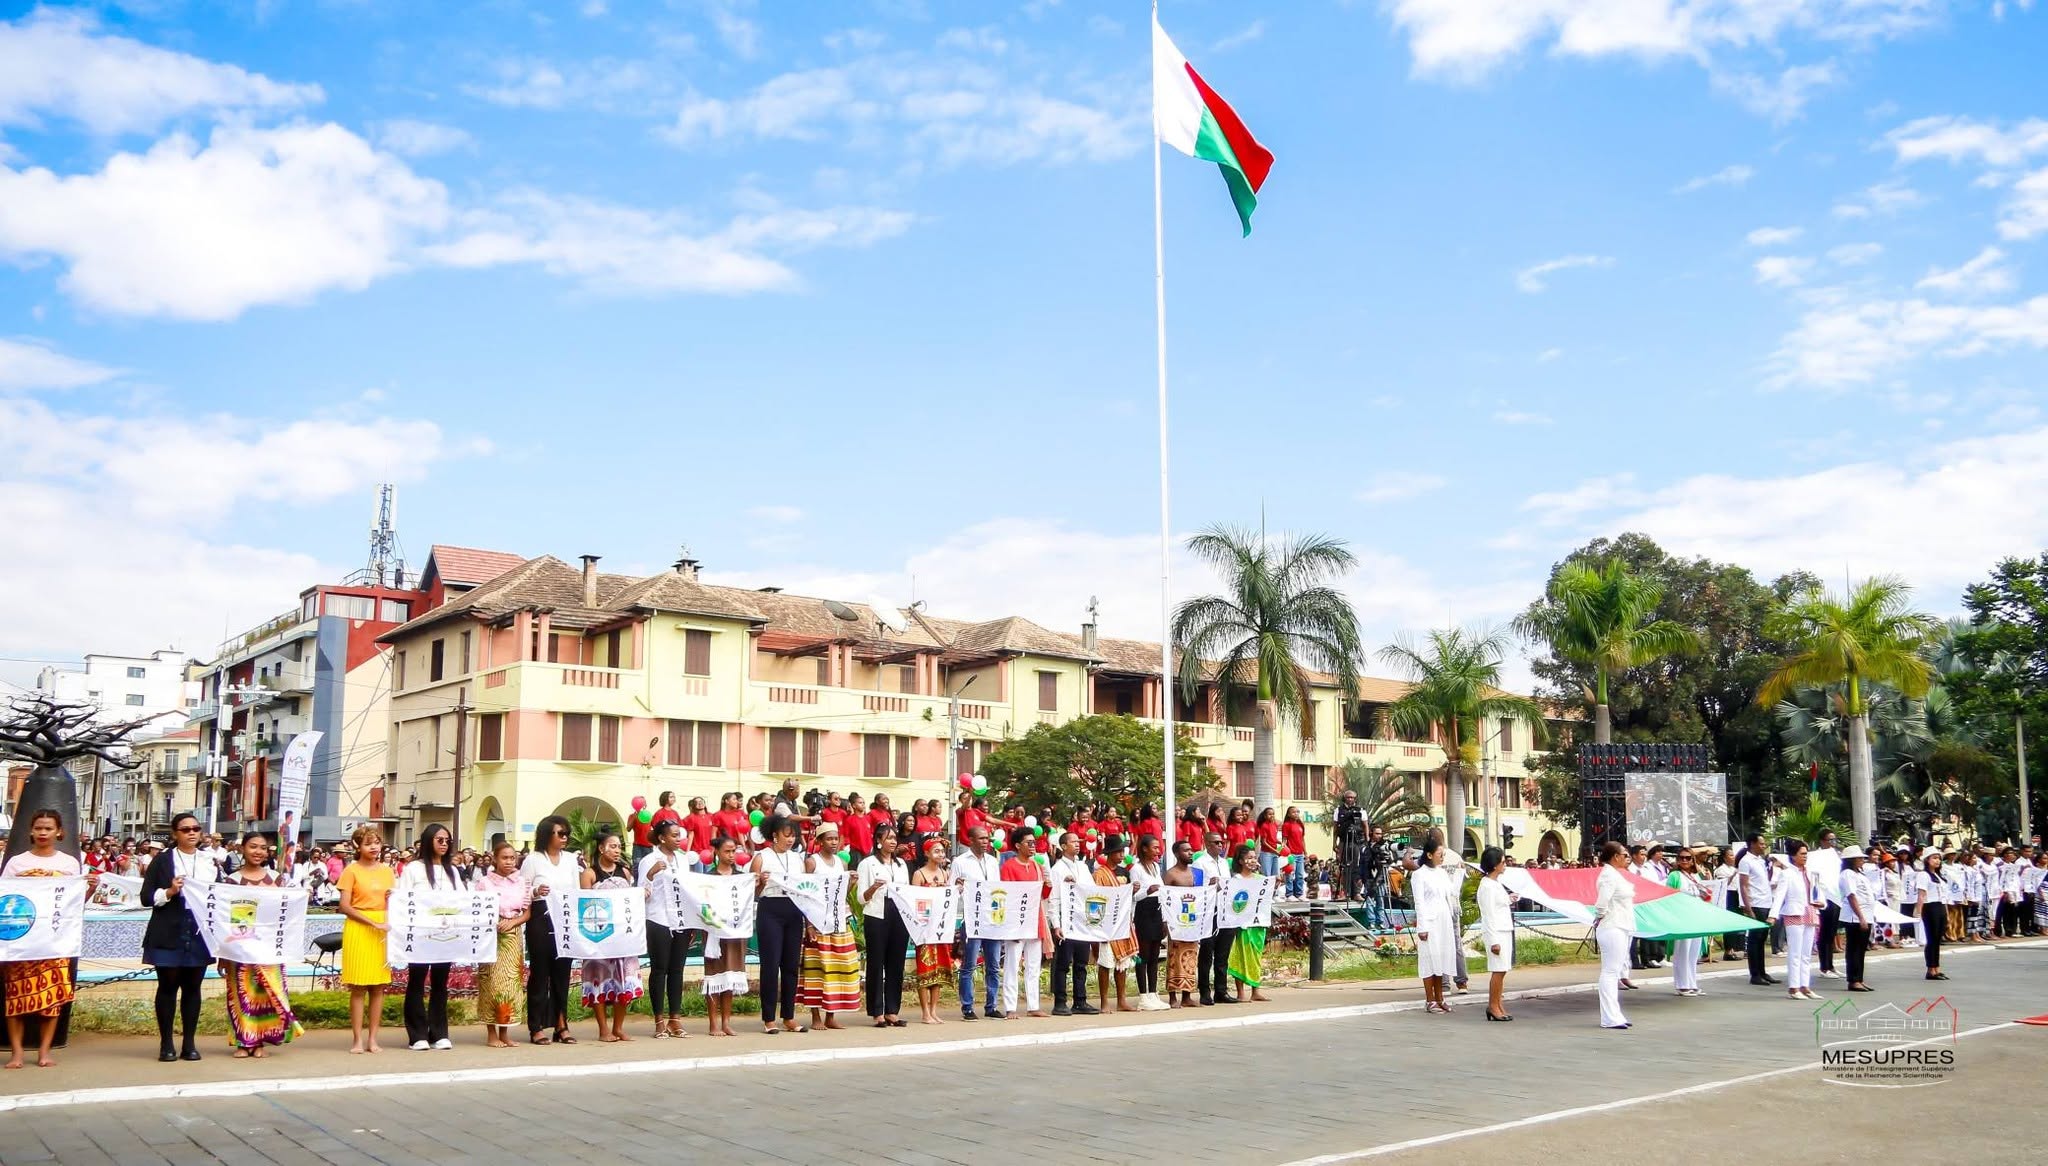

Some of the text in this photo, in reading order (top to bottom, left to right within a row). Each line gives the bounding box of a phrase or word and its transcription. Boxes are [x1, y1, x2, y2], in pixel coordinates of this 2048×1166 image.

[52, 887, 65, 932] MELAKY
[405, 892, 416, 952] FARITRA
[624, 898, 632, 934] SAVA
[731, 885, 740, 928] ANDROY
[936, 889, 951, 940] BOINY
[1019, 893, 1028, 926] ANOSY
[1253, 879, 1269, 924] SOFIA
